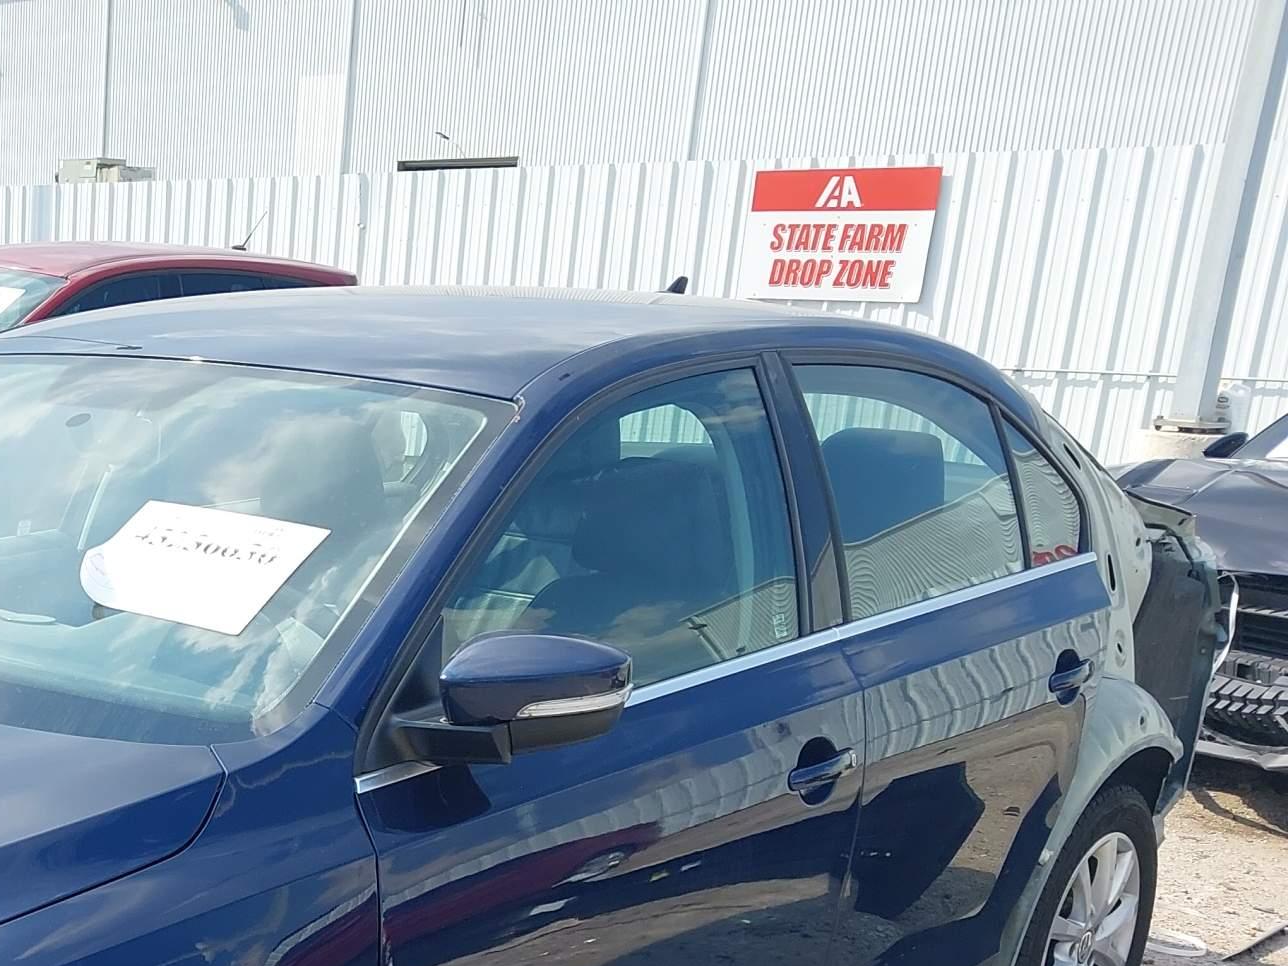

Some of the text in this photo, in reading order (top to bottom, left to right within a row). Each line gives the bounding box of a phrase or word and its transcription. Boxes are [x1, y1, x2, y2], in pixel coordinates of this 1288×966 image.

[769, 223, 908, 253] STATE FARM
[768, 258, 896, 290] DROP ZONE
